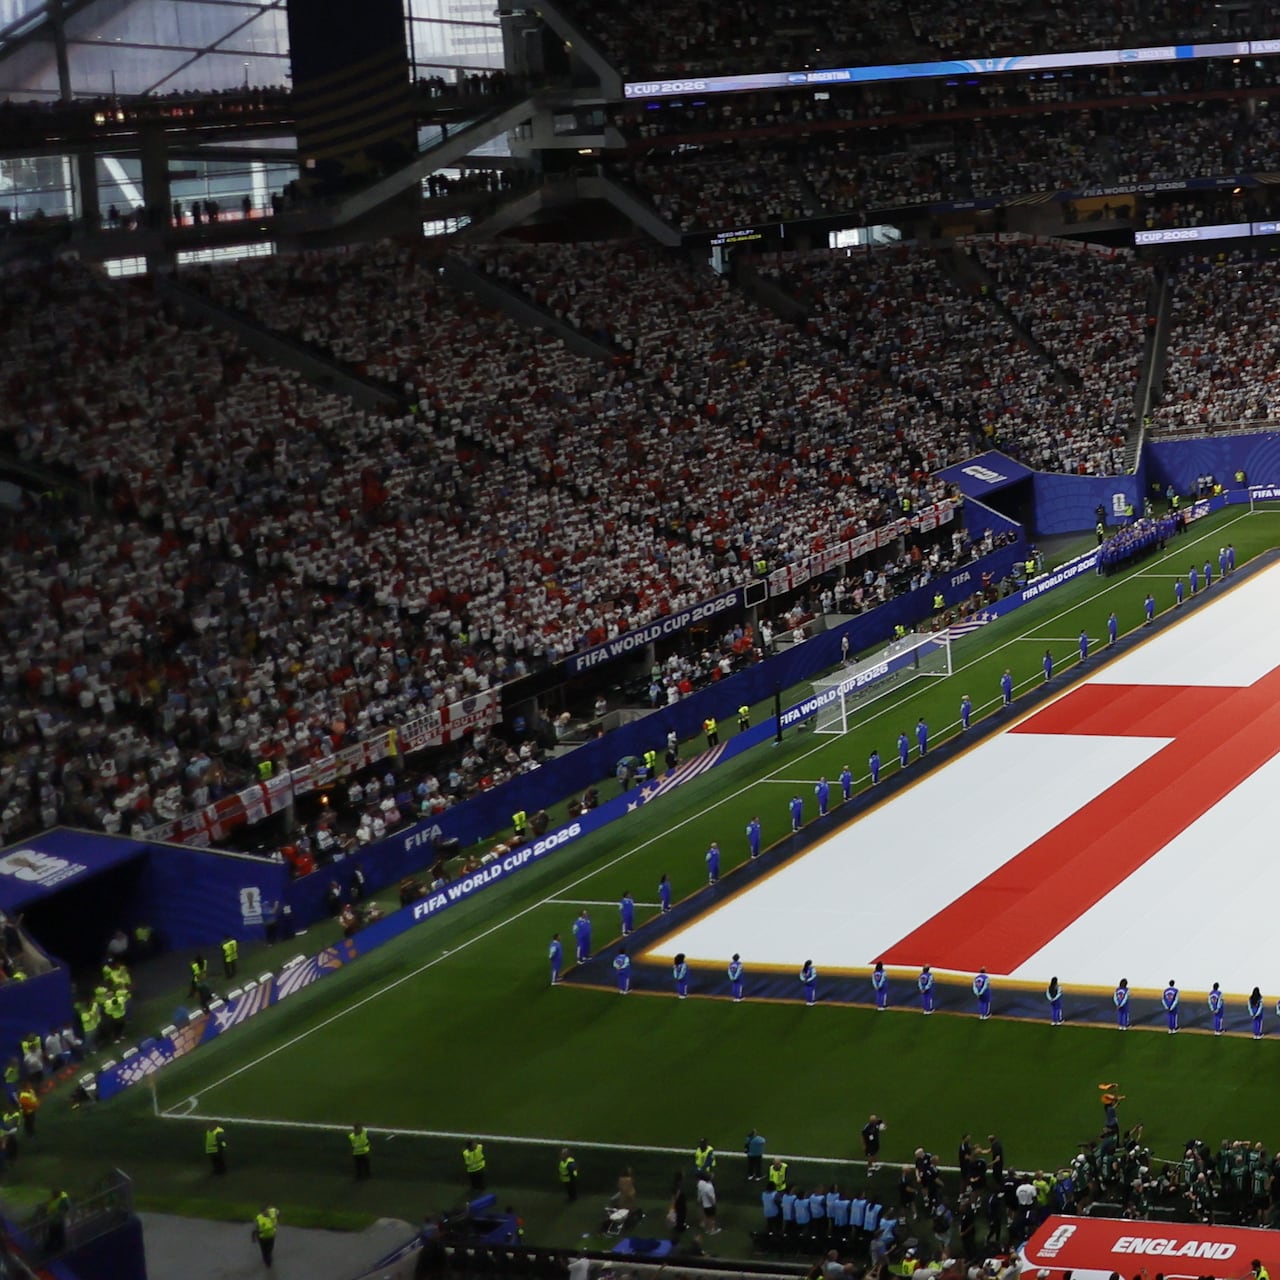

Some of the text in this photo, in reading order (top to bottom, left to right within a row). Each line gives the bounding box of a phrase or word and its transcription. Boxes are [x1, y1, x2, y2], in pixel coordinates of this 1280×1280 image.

[634, 84, 660, 94] CUP
[661, 81, 706, 93] 2026
[807, 71, 851, 83] ARGENTINA
[1104, 185, 1136, 195] WORLD
[1137, 183, 1154, 193] CUP
[1154, 181, 1187, 191] 2026
[1142, 232, 1163, 242] CUP
[1163, 230, 1199, 240] 2026
[1253, 489, 1273, 499] FIFA
[950, 570, 971, 589] FIFA
[1022, 588, 1039, 601] FIFA
[1037, 575, 1063, 593] WORLD
[1062, 567, 1079, 580] CUP
[576, 592, 738, 671] FIFA WORLD CUP 2026
[800, 690, 836, 715] WORLD
[836, 678, 857, 697] CUP
[856, 662, 890, 687] 2026
[404, 823, 443, 852] FIFA
[413, 822, 582, 920] FIFA WORLD CUP 2026
[1110, 1236, 1238, 1261] ENGLAND
